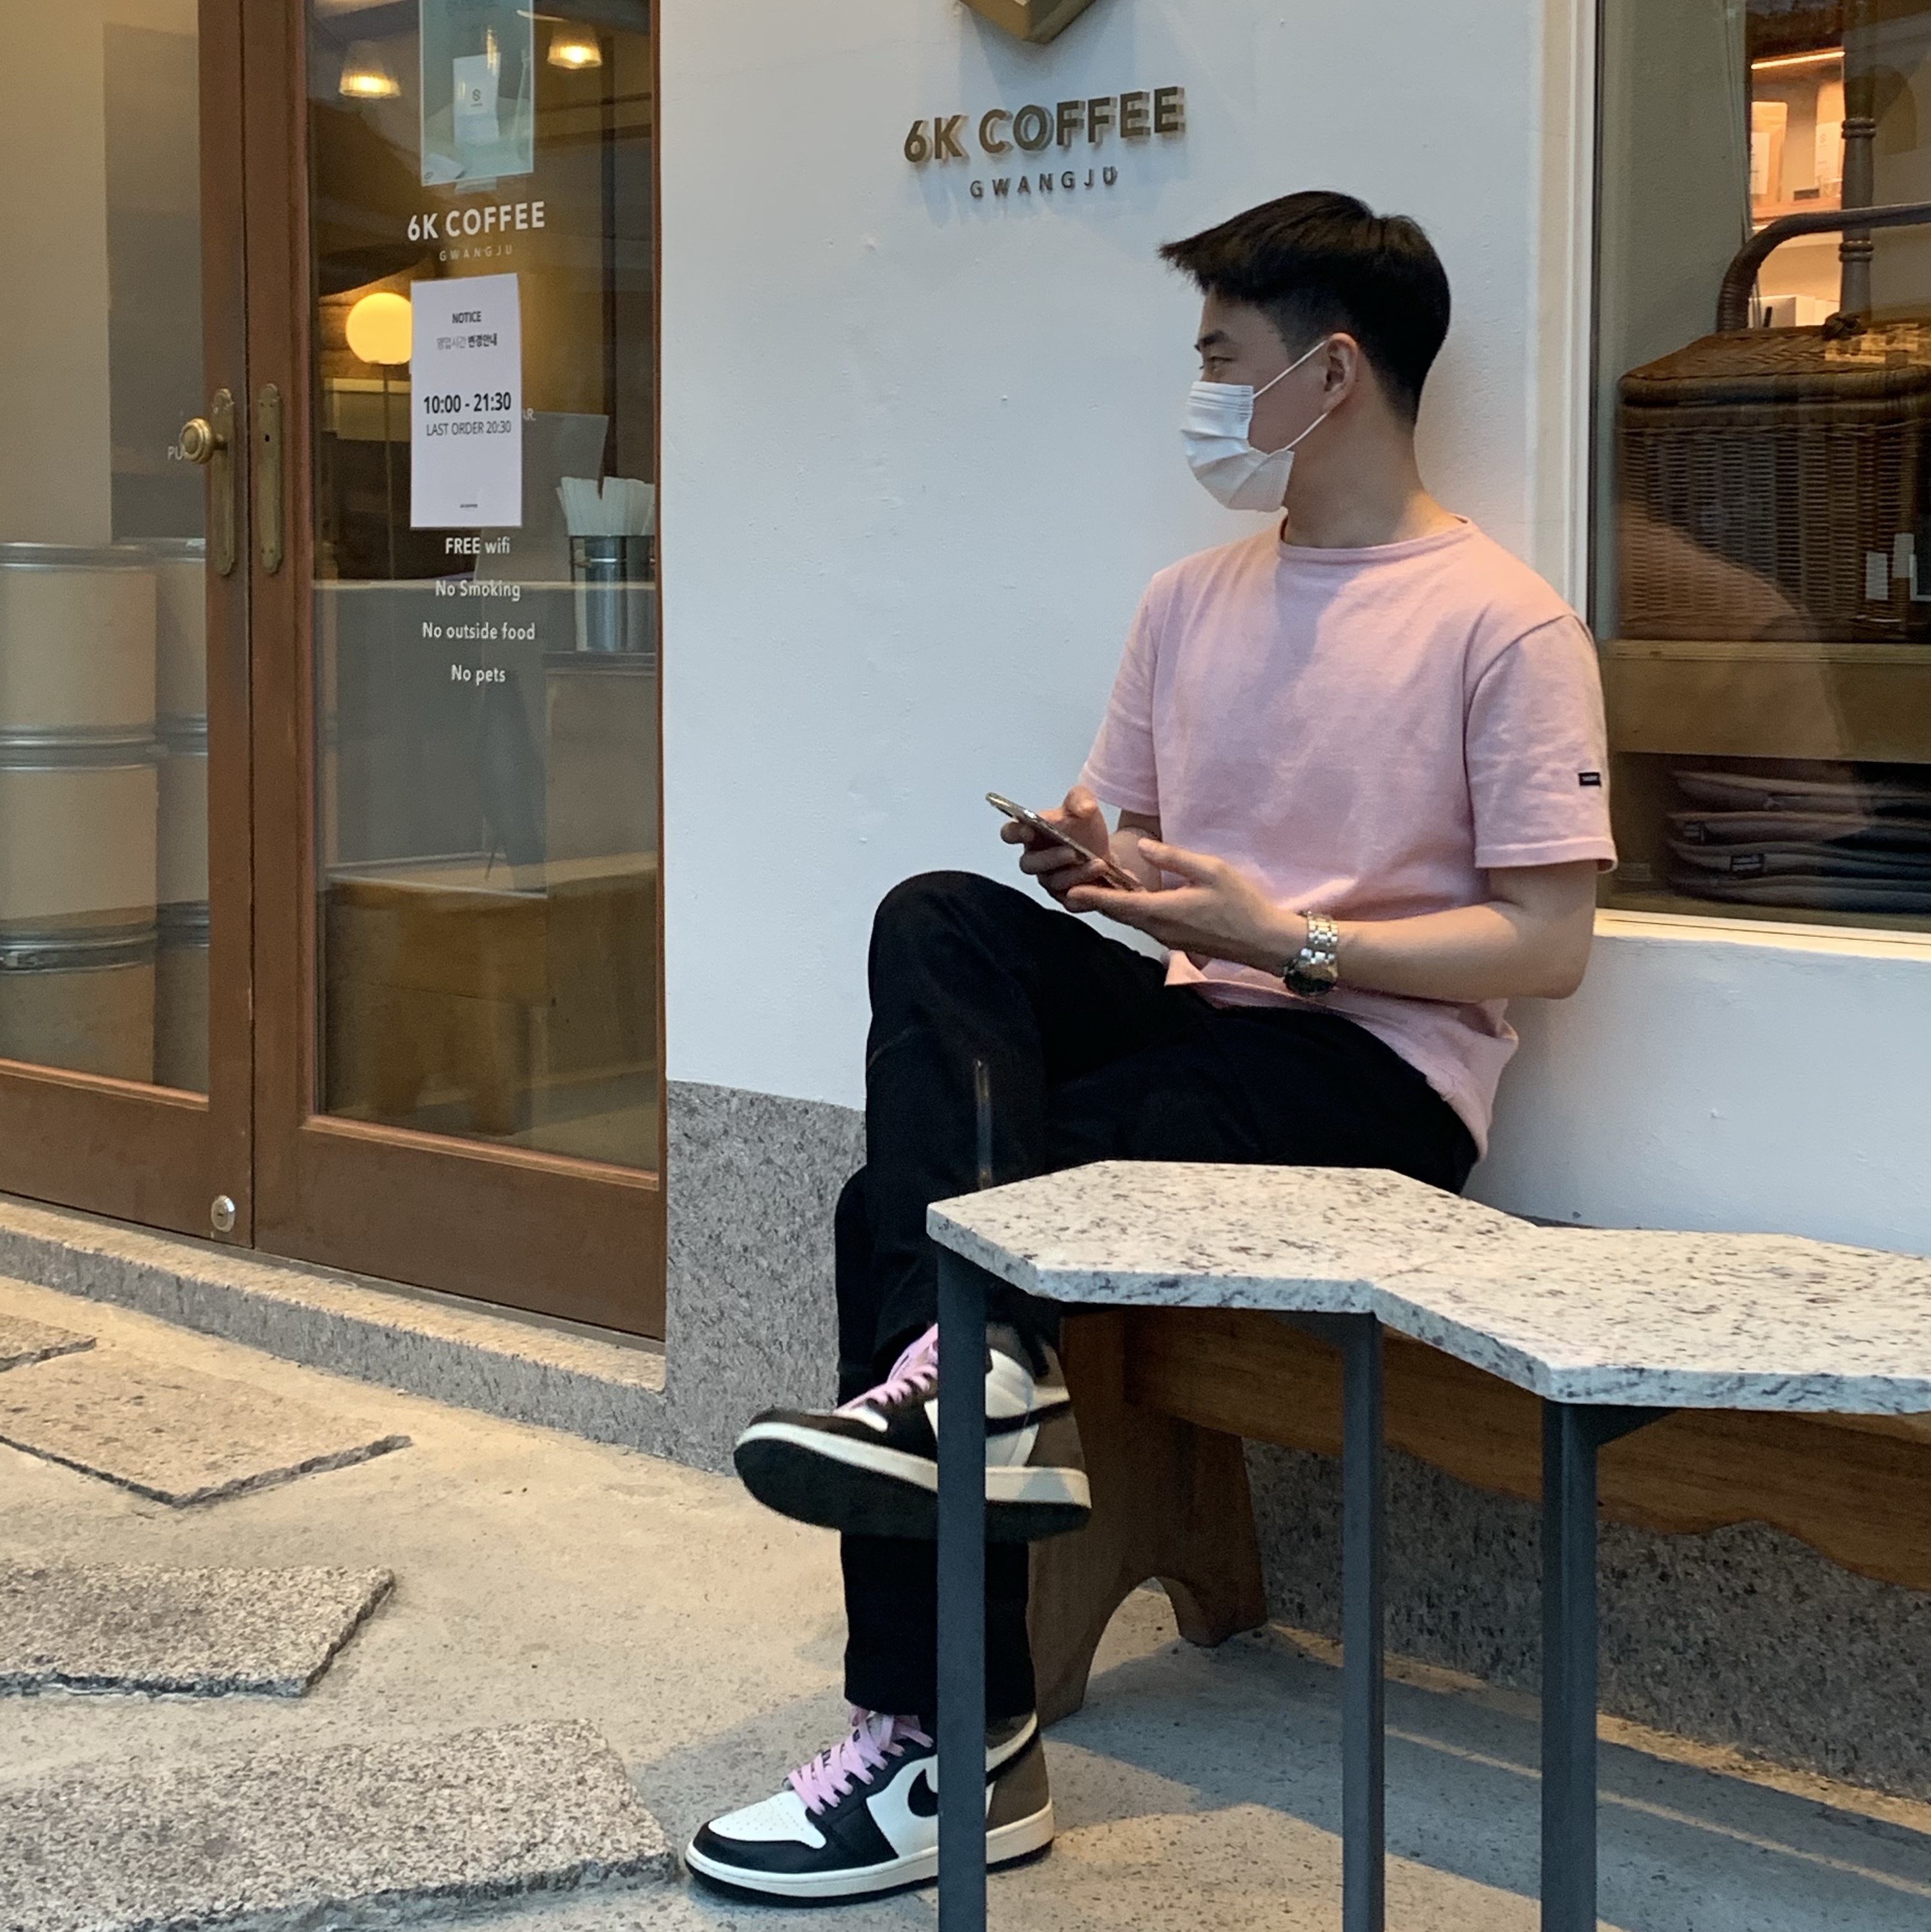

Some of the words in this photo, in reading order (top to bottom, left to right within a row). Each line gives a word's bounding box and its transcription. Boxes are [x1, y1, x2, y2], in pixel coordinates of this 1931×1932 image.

[904, 114, 969, 163] 6K
[979, 86, 1185, 154] COFFEE
[970, 166, 1117, 198] GWANGJU
[407, 213, 439, 241] 6K
[445, 201, 545, 238] COFFEE
[439, 245, 512, 262] GWANGJU
[451, 311, 481, 324] NOTICE
[423, 394, 462, 415] 10:00
[473, 392, 511, 412] 21:30
[426, 422, 449, 436] LAST
[451, 421, 485, 436] ORDER
[486, 420, 511, 434] 20:30
[445, 537, 481, 554] FREE
[485, 536, 510, 554] wifi
[435, 580, 455, 597] No
[460, 579, 521, 602] Smoking
[422, 622, 442, 638] No
[446, 621, 498, 639] outside
[502, 621, 536, 639] food
[451, 664, 471, 681] No
[476, 667, 506, 686] pets
